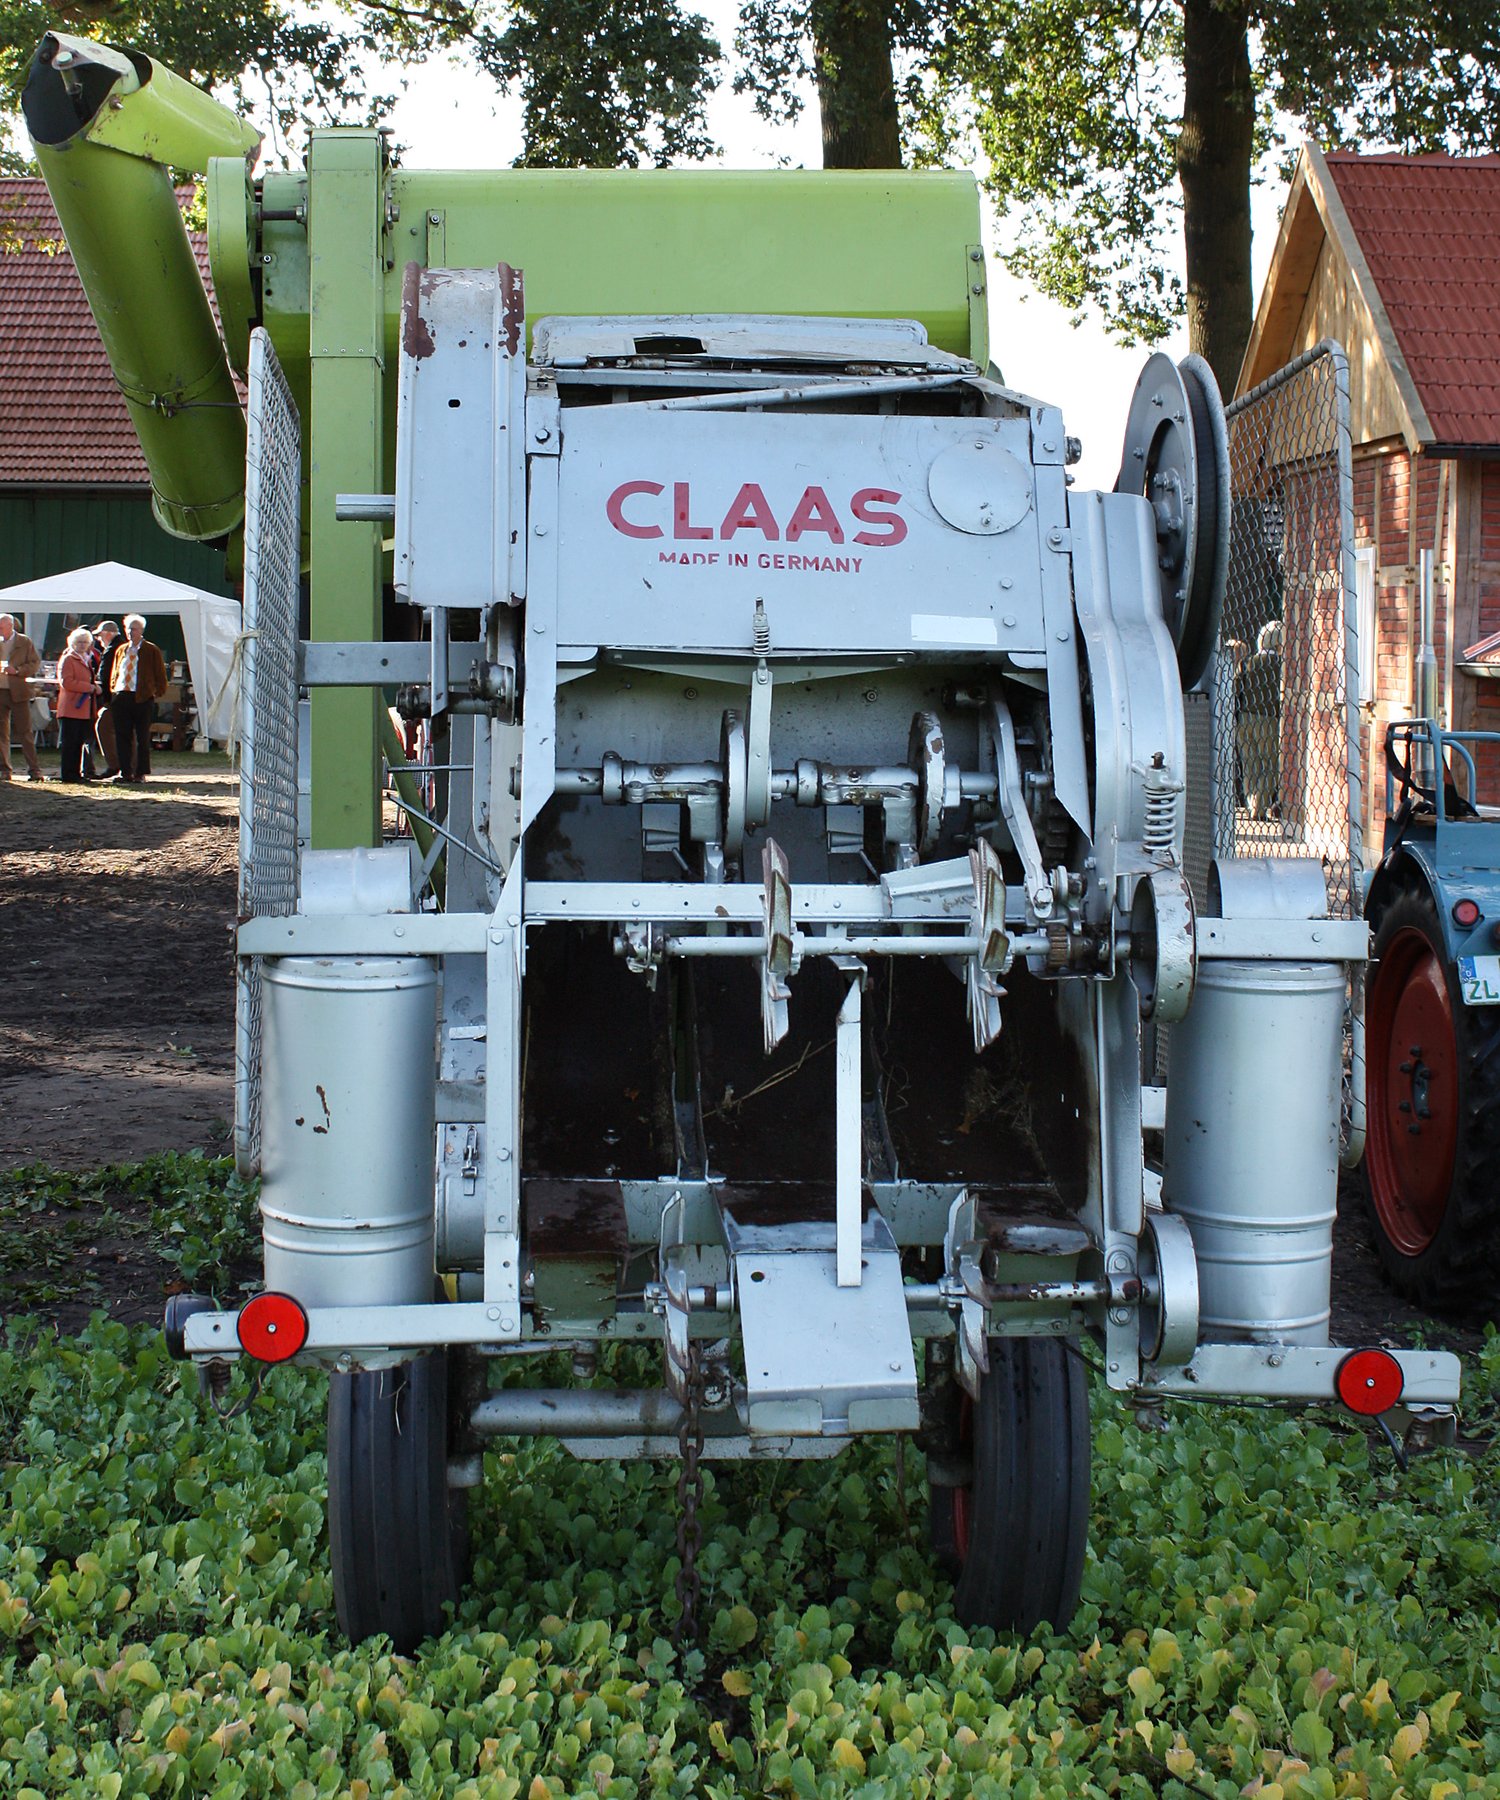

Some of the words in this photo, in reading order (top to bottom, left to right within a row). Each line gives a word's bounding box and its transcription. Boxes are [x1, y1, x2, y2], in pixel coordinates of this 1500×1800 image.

[606, 480, 908, 547] CLAAS
[728, 553, 748, 567] IN
[757, 553, 862, 573] GERMANY
